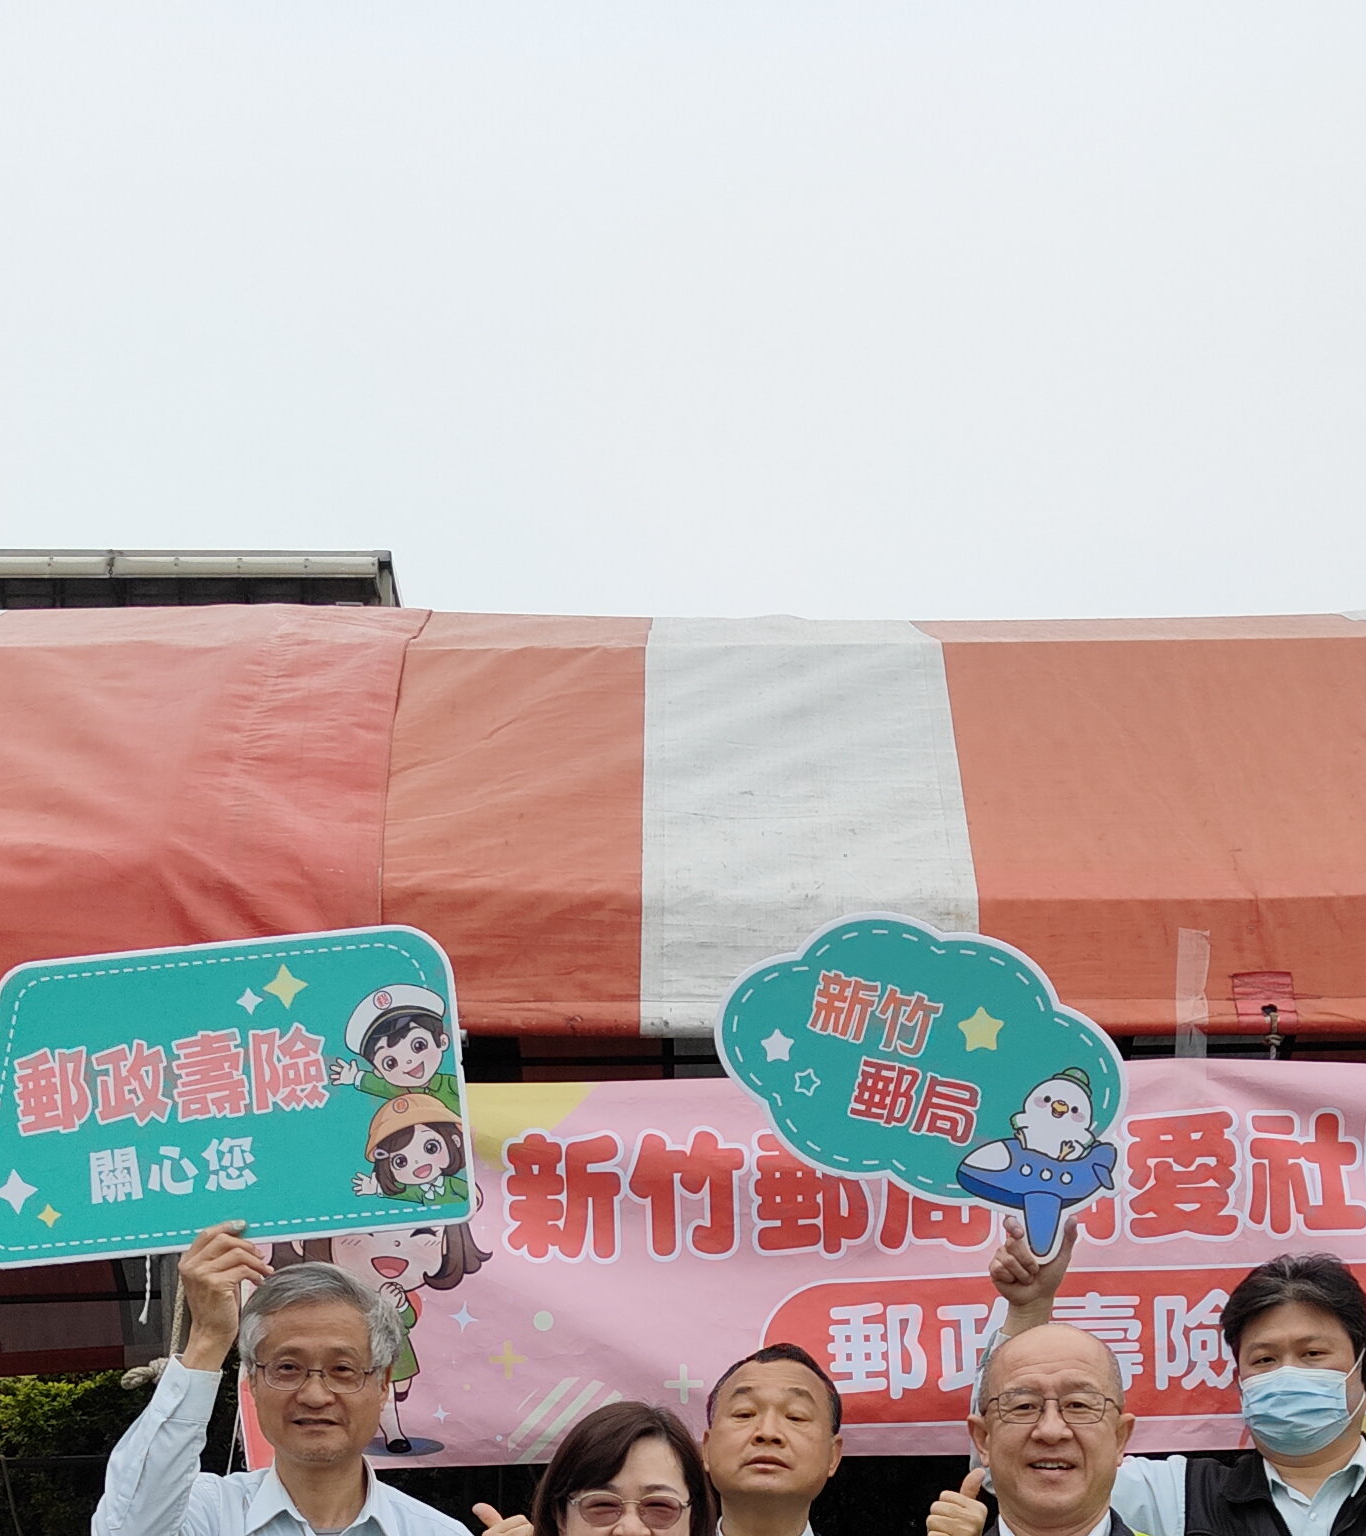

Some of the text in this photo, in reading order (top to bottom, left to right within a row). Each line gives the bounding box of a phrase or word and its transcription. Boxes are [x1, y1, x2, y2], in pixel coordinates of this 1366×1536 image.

[806, 969, 942, 1058] 新竹
[13, 1022, 331, 1138] 郵政壽險
[847, 1056, 983, 1149] 郵局
[89, 1135, 257, 1204] 關心您
